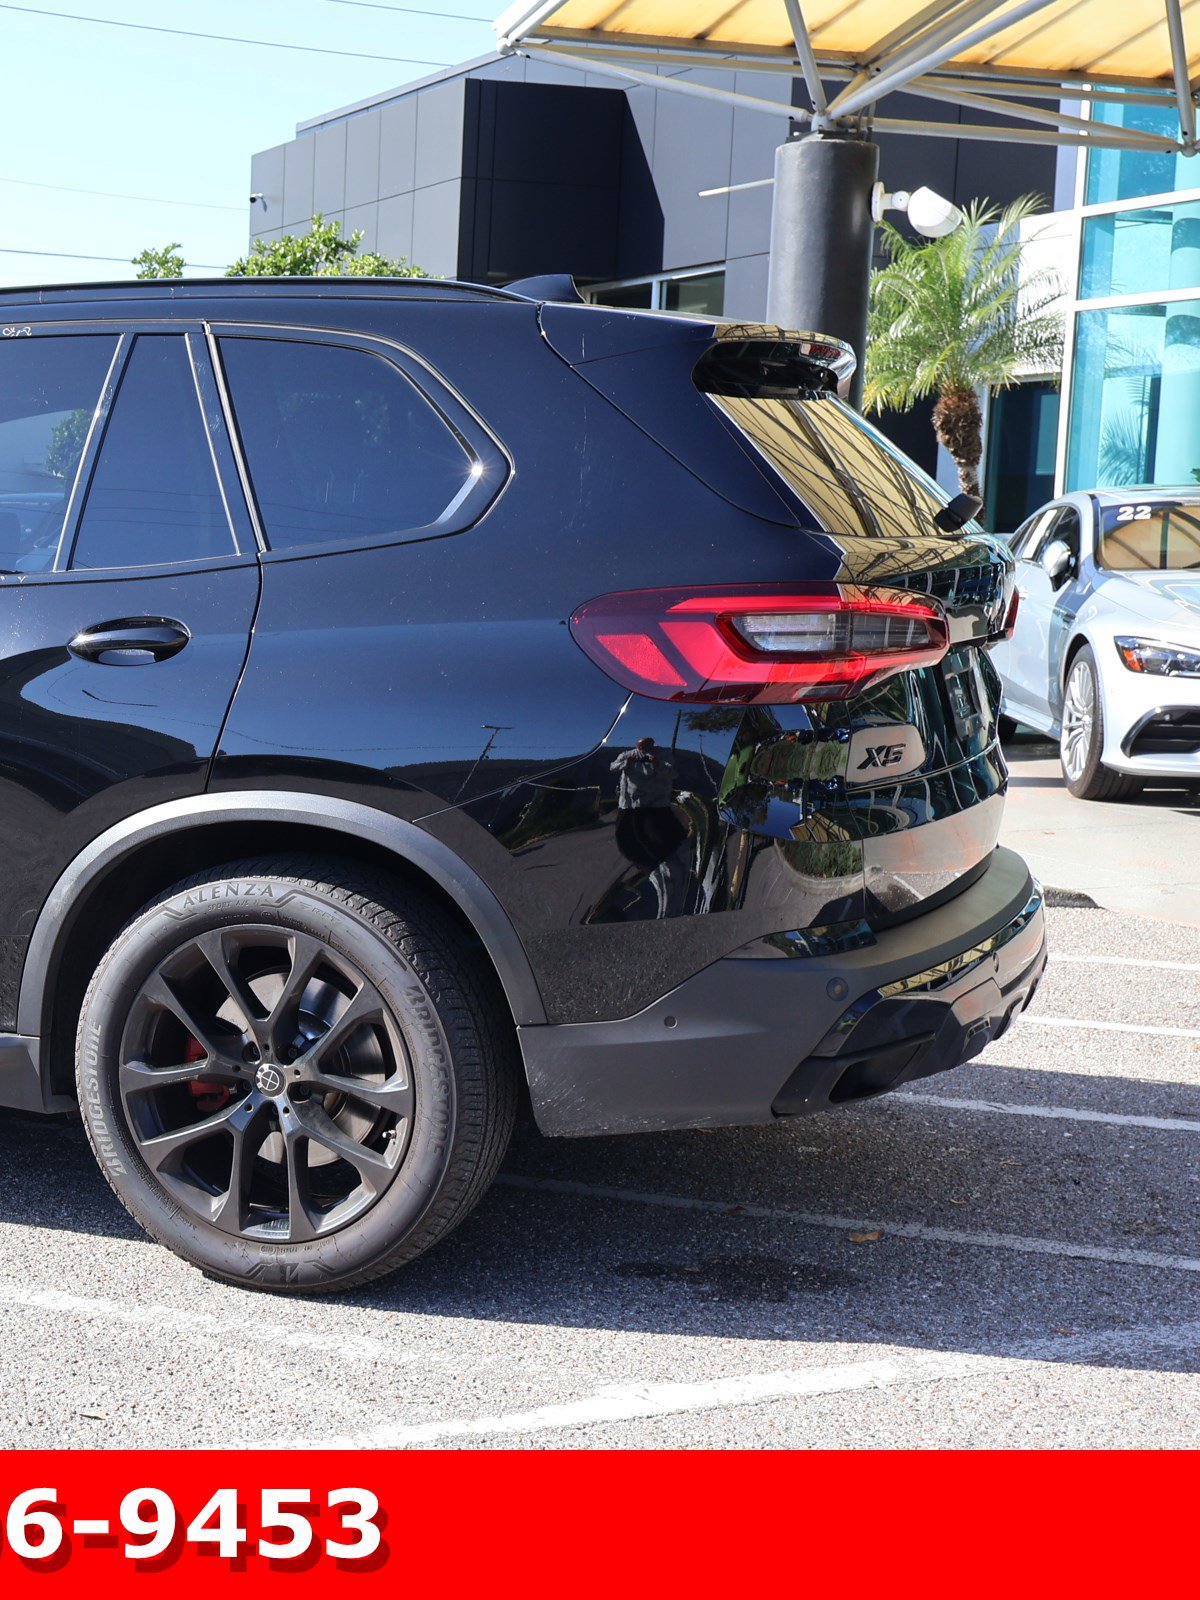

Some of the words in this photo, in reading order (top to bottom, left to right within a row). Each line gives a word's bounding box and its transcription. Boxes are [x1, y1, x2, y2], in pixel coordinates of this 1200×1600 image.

[1116, 505, 1152, 521] 22
[856, 743, 906, 769] X5
[183, 883, 274, 908] ALENZA
[85, 1022, 128, 1178] BRIDGESTONE
